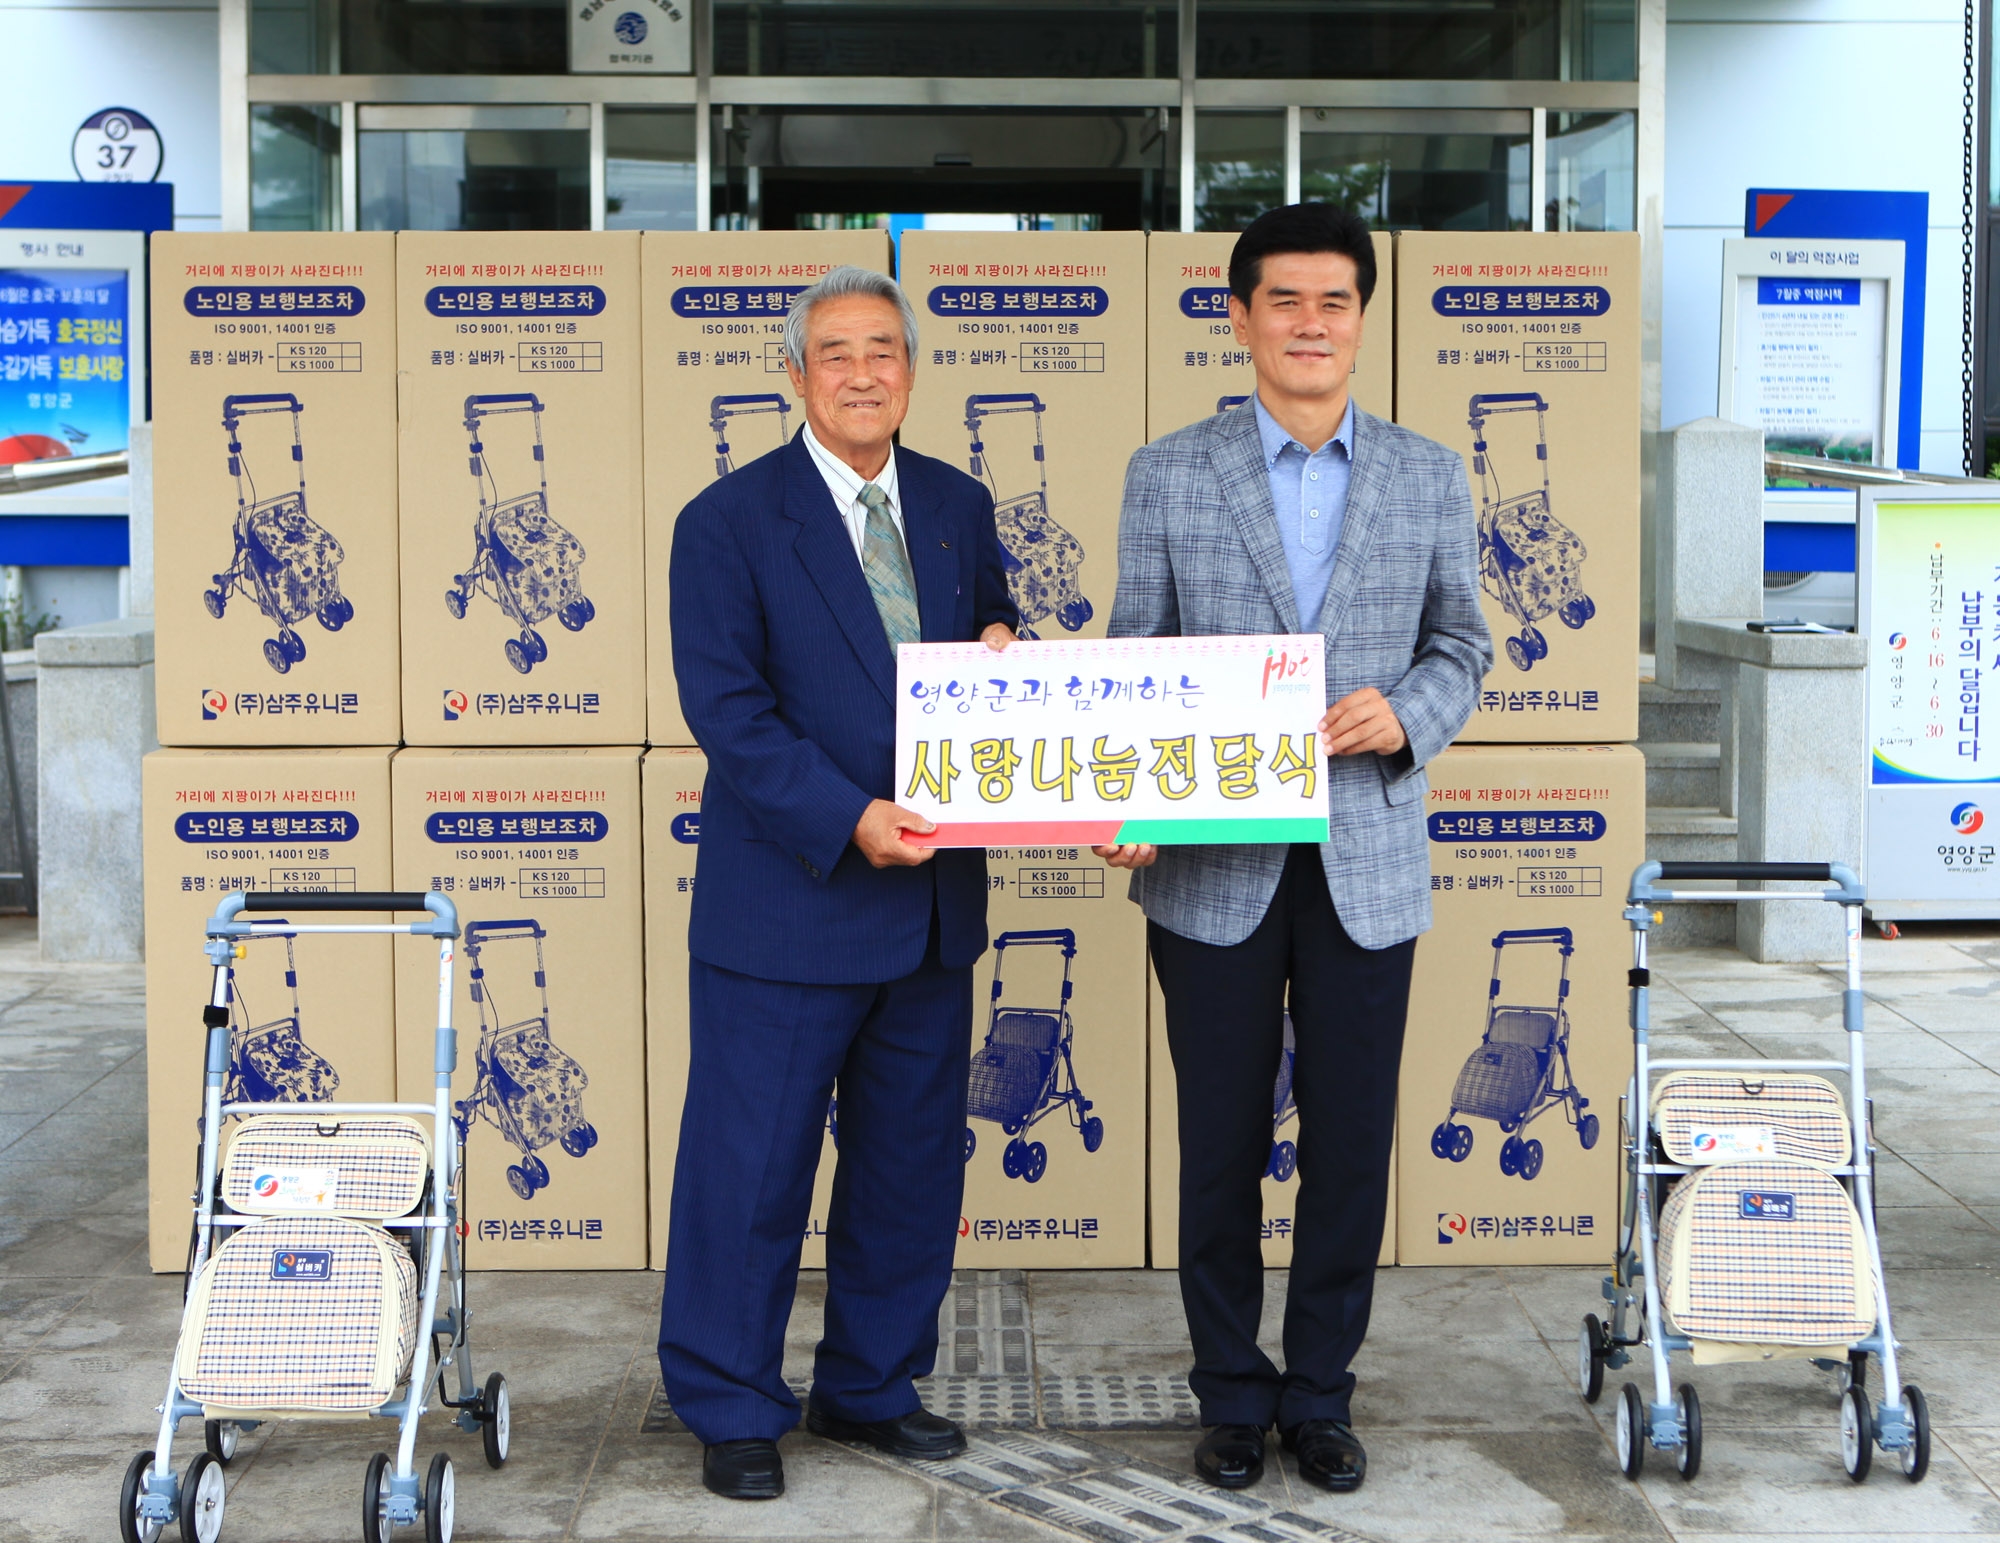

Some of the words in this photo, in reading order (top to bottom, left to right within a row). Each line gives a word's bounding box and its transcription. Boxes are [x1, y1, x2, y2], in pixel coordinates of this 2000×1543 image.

[98, 145, 137, 168] 37
[56, 242, 84, 257] 안내
[1770, 251, 1782, 264] 이
[1786, 251, 1809, 264] 달의
[1813, 251, 1859, 265] 역점사업
[186, 265, 224, 277] 거리에
[232, 265, 284, 277] 지팡이가
[291, 265, 362, 277] 사라진다!!!
[426, 265, 465, 277] 거리에
[472, 265, 525, 277] 지팡이가
[531, 265, 602, 276] 사라진다!!!
[672, 265, 711, 277] 거리에
[718, 265, 771, 277] 지팡이가
[929, 264, 968, 276] 거리에
[975, 265, 1028, 277] 지팡이가
[1034, 265, 1105, 277] 사라진다!!!
[1181, 266, 1221, 278] 거리에
[1433, 265, 1472, 276] 거리에
[1478, 265, 1531, 277] 지팡이가
[1537, 265, 1607, 277] 사라진다!!!
[197, 293, 252, 311] 노인용
[259, 292, 353, 310] 보행보조차
[438, 293, 494, 310] 노인용
[500, 292, 594, 310] 보행보조차
[684, 293, 740, 311] 노인용
[940, 292, 996, 310] 노인용
[1003, 292, 1097, 310] 보행보조차
[1445, 292, 1500, 310] 노인용
[1506, 292, 1599, 310] 보행보조차
[0, 318, 51, 344] 슴가득
[57, 318, 123, 345] 호국정신
[215, 324, 236, 333] ISO
[240, 324, 271, 334] 9001,
[276, 324, 309, 333] 14001
[314, 323, 336, 334] 인증
[457, 324, 477, 333] ISO
[481, 324, 512, 334] 9001,
[518, 324, 550, 333] 14001
[555, 323, 577, 334] 인증
[703, 325, 723, 334] ISO
[727, 324, 759, 334] 9001,
[959, 324, 979, 333] ISO
[983, 324, 1015, 333] 9001,
[1020, 324, 1052, 333] 14001
[1058, 324, 1079, 334] 인증
[1209, 325, 1231, 335] ISO
[1463, 324, 1483, 333] ISO
[1487, 324, 1518, 333] 9001,
[1523, 324, 1555, 333] 14001
[1560, 323, 1581, 334] 인증
[190, 351, 213, 365] 품명
[227, 350, 263, 365] 실버카
[290, 346, 305, 355] KS
[308, 346, 327, 355] 120
[431, 351, 454, 365] 품명
[468, 350, 504, 364] 실버카
[531, 346, 546, 355] KS
[549, 346, 568, 355] 120
[933, 350, 956, 364] 품명
[970, 350, 1006, 364] 실버카
[1032, 346, 1048, 355] KS
[1051, 346, 1070, 355] 120
[1437, 350, 1460, 364] 품명
[1474, 350, 1509, 364] 실버카
[1535, 346, 1551, 355] KS
[1554, 346, 1572, 355] 120
[290, 361, 305, 370] KS
[308, 361, 334, 370] 1000
[531, 361, 546, 370] KS
[549, 361, 575, 370] 1000
[677, 351, 700, 366] 품명
[714, 351, 751, 365] 실버카
[1032, 361, 1048, 370] KS
[1051, 361, 1077, 370] 1000
[1184, 351, 1208, 366] 품명
[1535, 361, 1551, 370] KS
[1554, 361, 1579, 370] 1000
[58, 354, 124, 381] 보훈사랑
[1958, 590, 1984, 662] 납부의
[1262, 648, 1313, 700] Hot
[910, 677, 1053, 714] 영양군과
[1064, 674, 1205, 711] 함께하는
[235, 692, 359, 716] (주)삼주유니콘
[476, 692, 600, 716] (주)삼주유니콘
[1957, 667, 1983, 762] 달입니다
[176, 791, 215, 803] 거리에
[222, 790, 276, 802] 지팡이가
[283, 790, 354, 802] 사라진다!!!
[426, 791, 465, 803] 거리에
[472, 791, 526, 803] 지팡이가
[533, 790, 604, 802] 사라진다!!!
[1432, 789, 1470, 801] 거리에
[1478, 789, 1531, 801] 지팡이가
[1537, 789, 1608, 800] 사라진다!!!
[188, 818, 244, 836] 노인용
[251, 817, 347, 836] 보행보조차
[438, 818, 494, 836] 노인용
[501, 818, 596, 836] 보행보조차
[1438, 818, 1494, 835] 노인용
[1500, 817, 1595, 835] 보행보조차
[207, 850, 228, 859] ISO
[232, 850, 264, 860] 9001,
[269, 850, 302, 859] 14001
[308, 849, 329, 860] 인증
[456, 850, 477, 859] ISO
[481, 850, 513, 860] 9001,
[519, 850, 551, 859] 14001
[557, 849, 579, 860] 인증
[1018, 850, 1052, 859] 14001
[1056, 849, 1079, 860] 인증
[1456, 849, 1477, 858] ISO
[1481, 849, 1512, 858] 9001,
[1517, 849, 1550, 858] 14001
[1555, 848, 1576, 859] 인증
[1937, 845, 1996, 865] 영양군
[532, 872, 547, 881] KS
[550, 872, 569, 881] 120
[1431, 876, 1453, 890] 품명
[1467, 875, 1503, 889] 실버카
[1529, 871, 1545, 880] KS
[1548, 871, 1566, 880] 120
[181, 877, 205, 891] 품명
[219, 876, 256, 891] 실버카
[431, 877, 454, 891] 품명
[469, 876, 505, 891] 실버카
[532, 886, 547, 895] KS
[551, 886, 577, 895] 1000
[1529, 885, 1545, 894] KS
[1548, 885, 1574, 894] 1000
[478, 1219, 603, 1242] (주)삼주유니콘
[974, 1218, 1099, 1241] (주)삼주유니콘
[1471, 1216, 1594, 1239] (주)삼주유니콘
